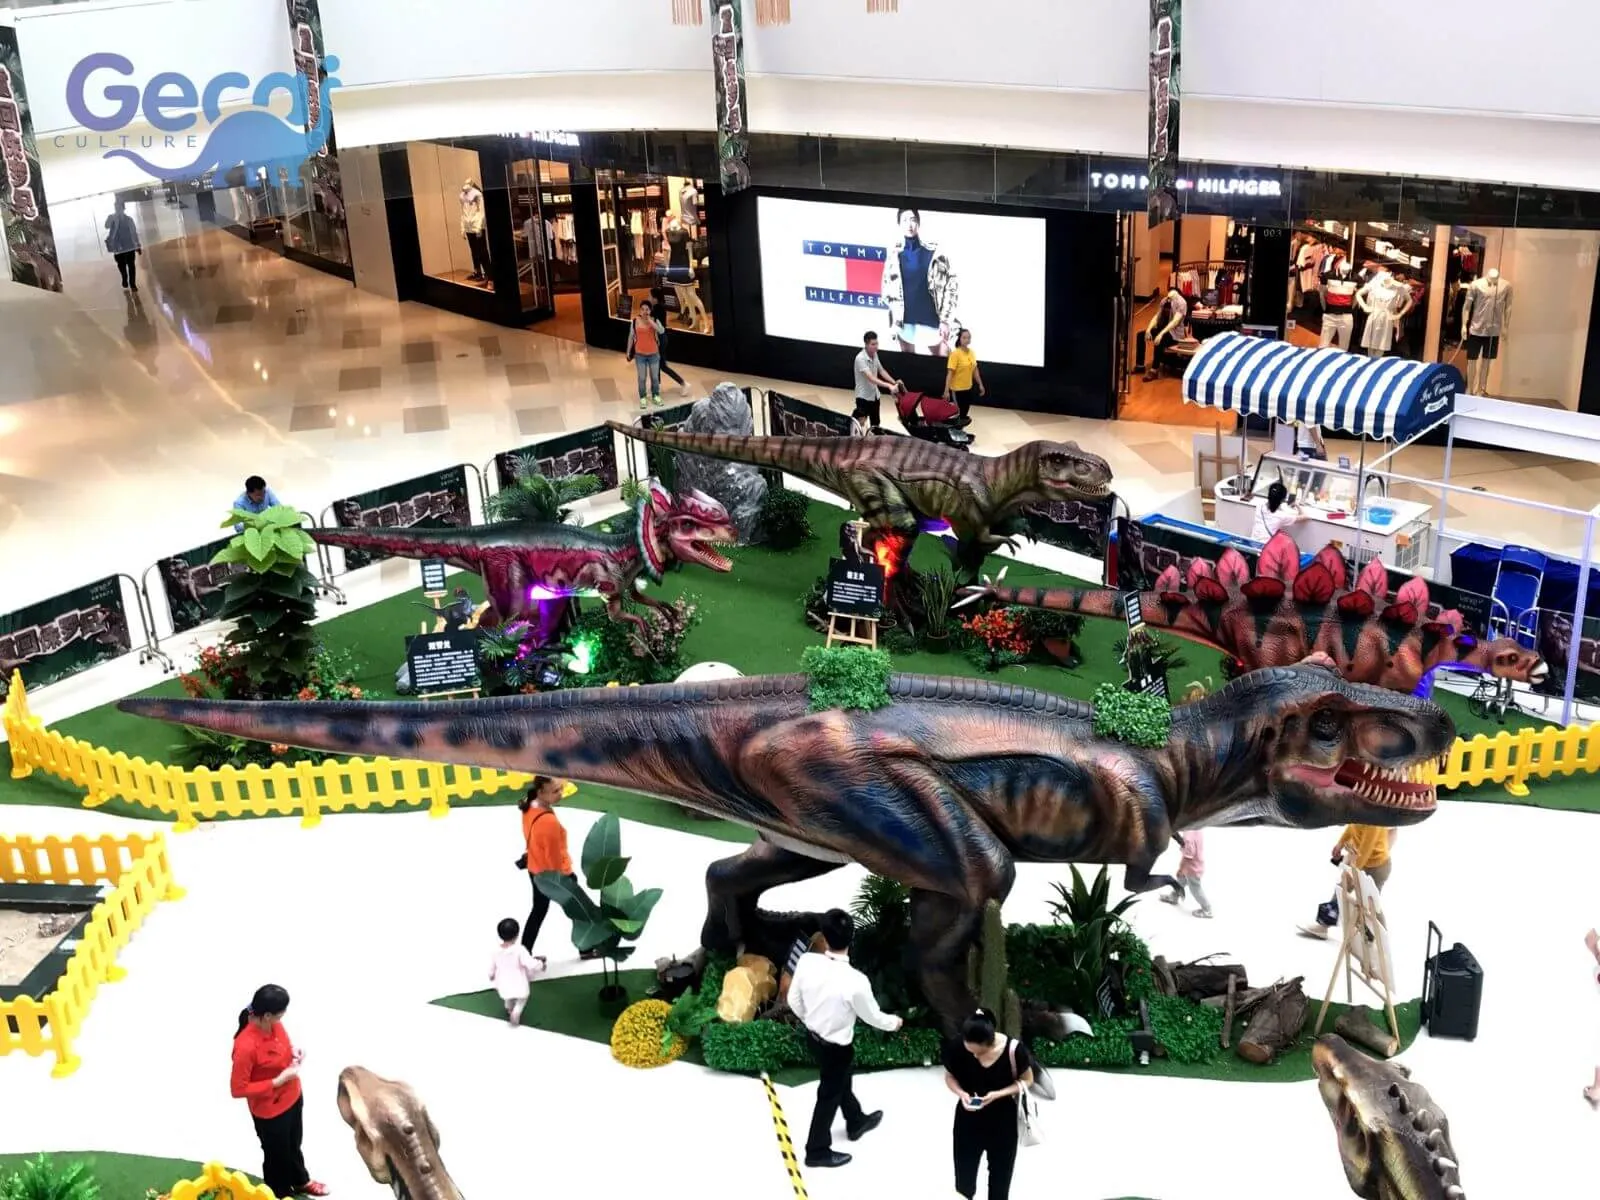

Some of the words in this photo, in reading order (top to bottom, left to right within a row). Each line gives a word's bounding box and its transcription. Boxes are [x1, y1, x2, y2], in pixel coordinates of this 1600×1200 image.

[1090, 172, 1149, 190] TOMM
[1197, 178, 1281, 196] HILFIGER
[807, 242, 883, 259] TOMMY
[809, 289, 885, 307] HILFIGER
